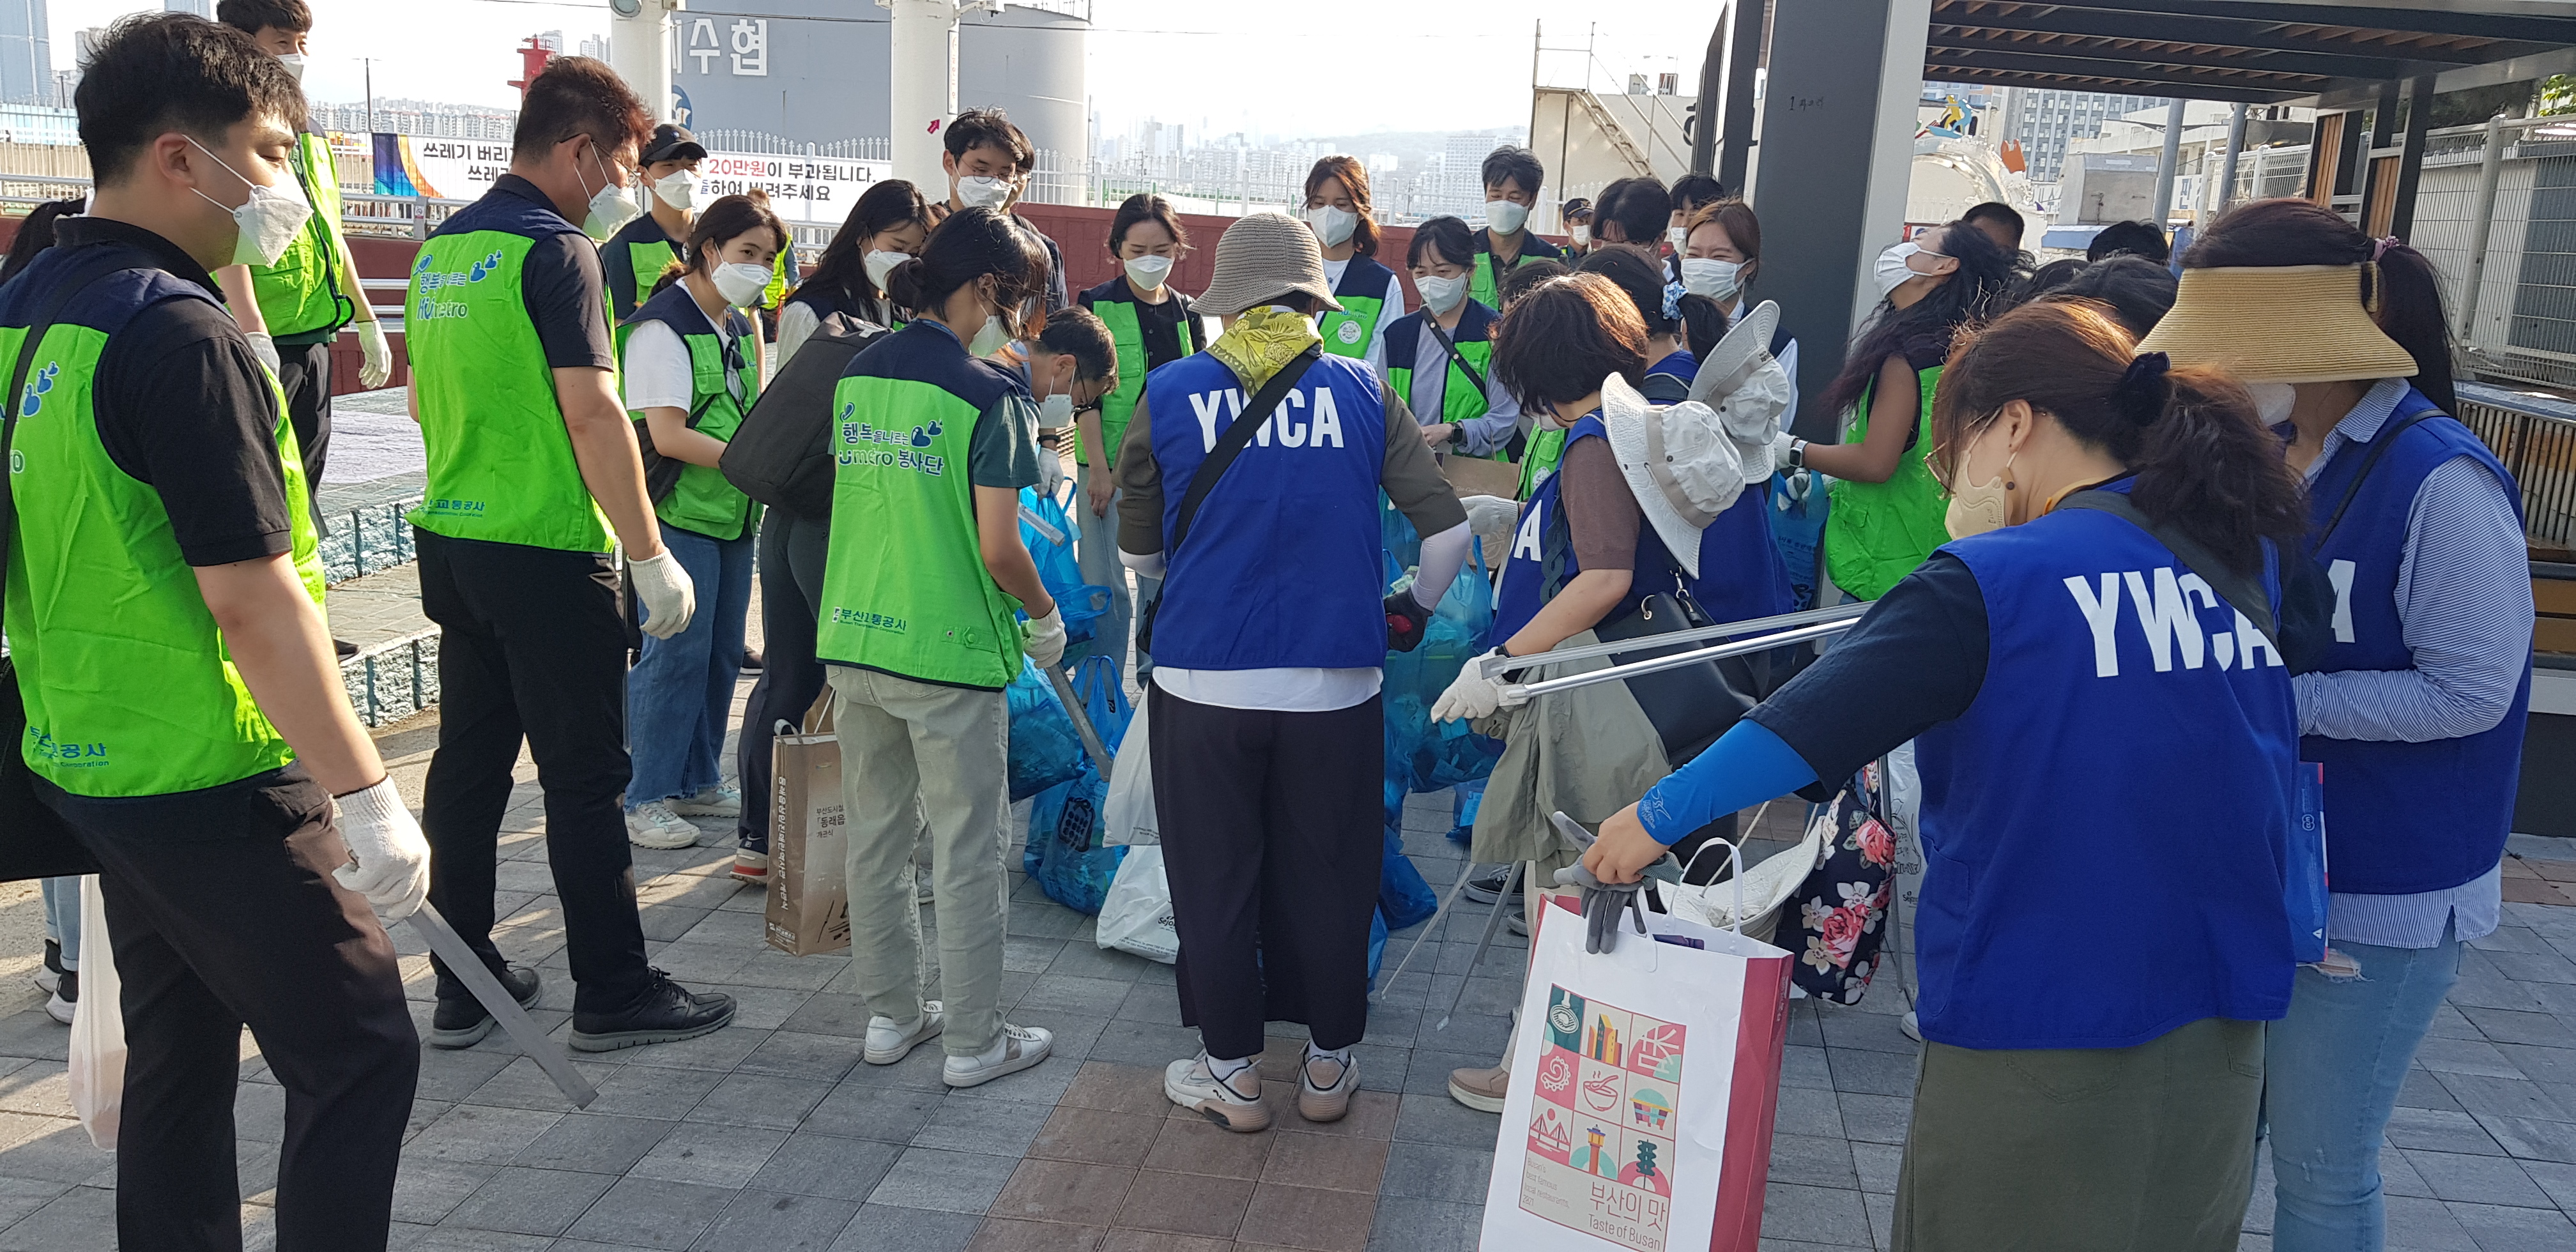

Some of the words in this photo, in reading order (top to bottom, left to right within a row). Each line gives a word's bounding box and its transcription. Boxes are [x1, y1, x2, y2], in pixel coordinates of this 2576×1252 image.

[424, 142, 471, 160] 쓰레기
[477, 146, 514, 162] 버리
[709, 159, 782, 178] 20만원이
[788, 163, 877, 183] 부과됩니다.
[898, 448, 944, 477] 봉사단
[1158, 917, 1176, 926] Sejo
[1590, 1181, 1643, 1225] 부산의
[1647, 1199, 1666, 1232] 맛
[1588, 1213, 1615, 1235] Taste
[1616, 1225, 1628, 1239] of
[1629, 1227, 1661, 1251] Busan
